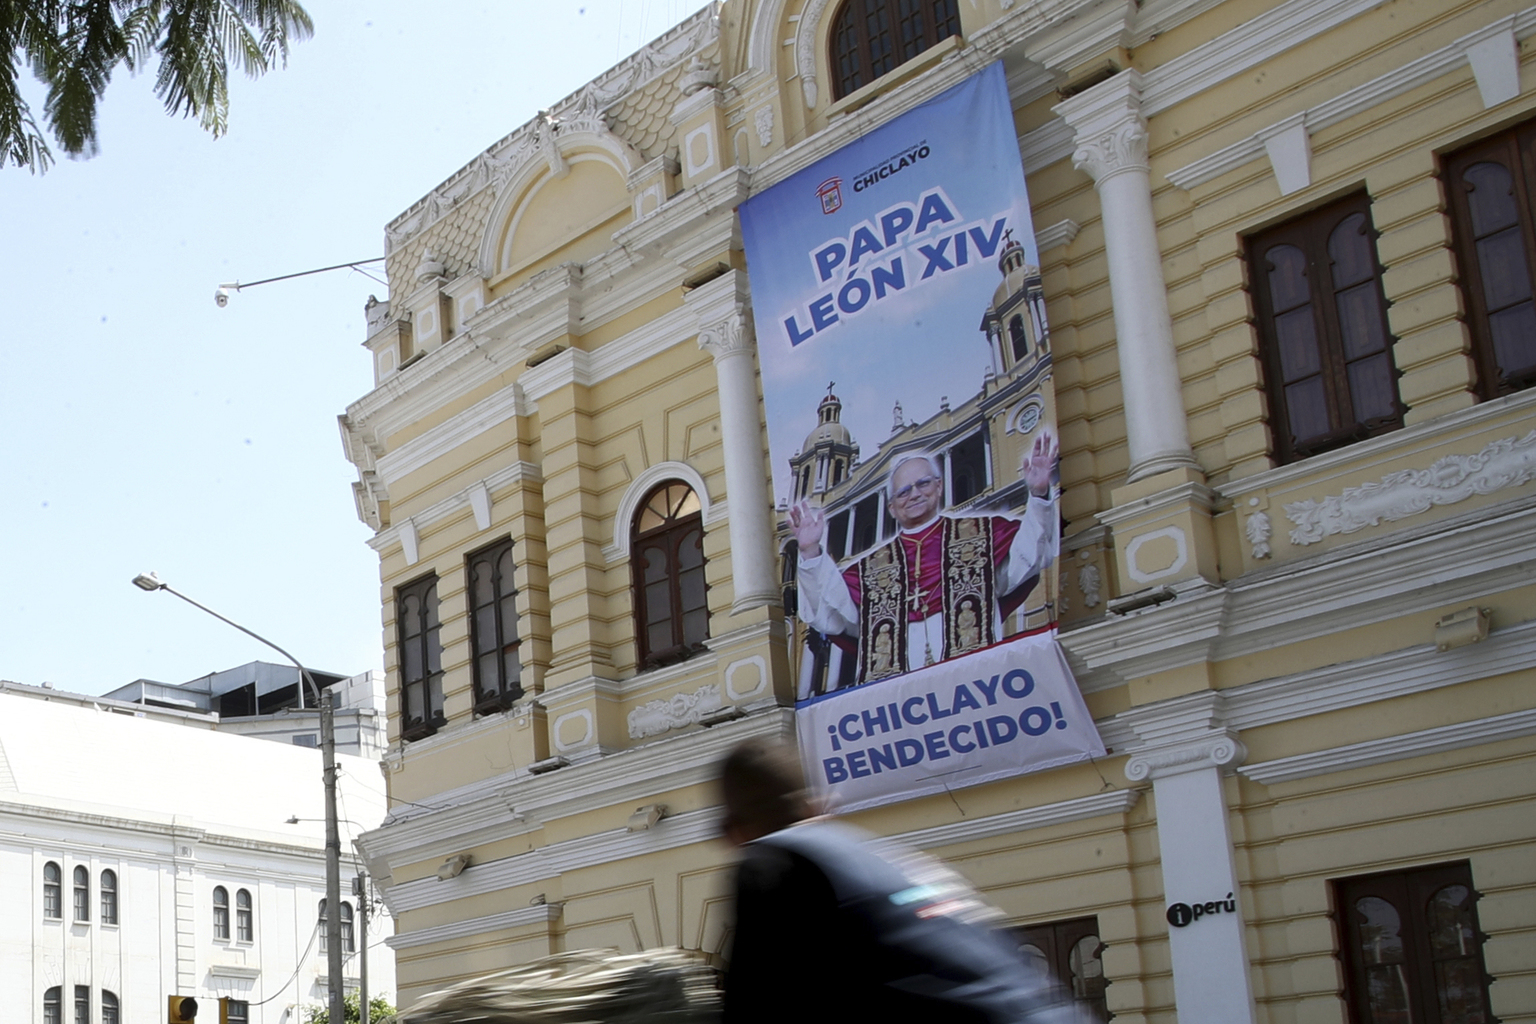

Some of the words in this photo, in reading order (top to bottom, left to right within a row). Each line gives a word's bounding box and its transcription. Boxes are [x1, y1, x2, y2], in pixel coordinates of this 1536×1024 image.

[853, 145, 930, 193] CHICLAYO
[815, 193, 955, 283] PAPA
[784, 256, 906, 347] LEÓN
[917, 217, 1007, 281] XIV
[823, 701, 1068, 785] BENDECIDO!
[828, 668, 1035, 751] ¡CHICLAYO
